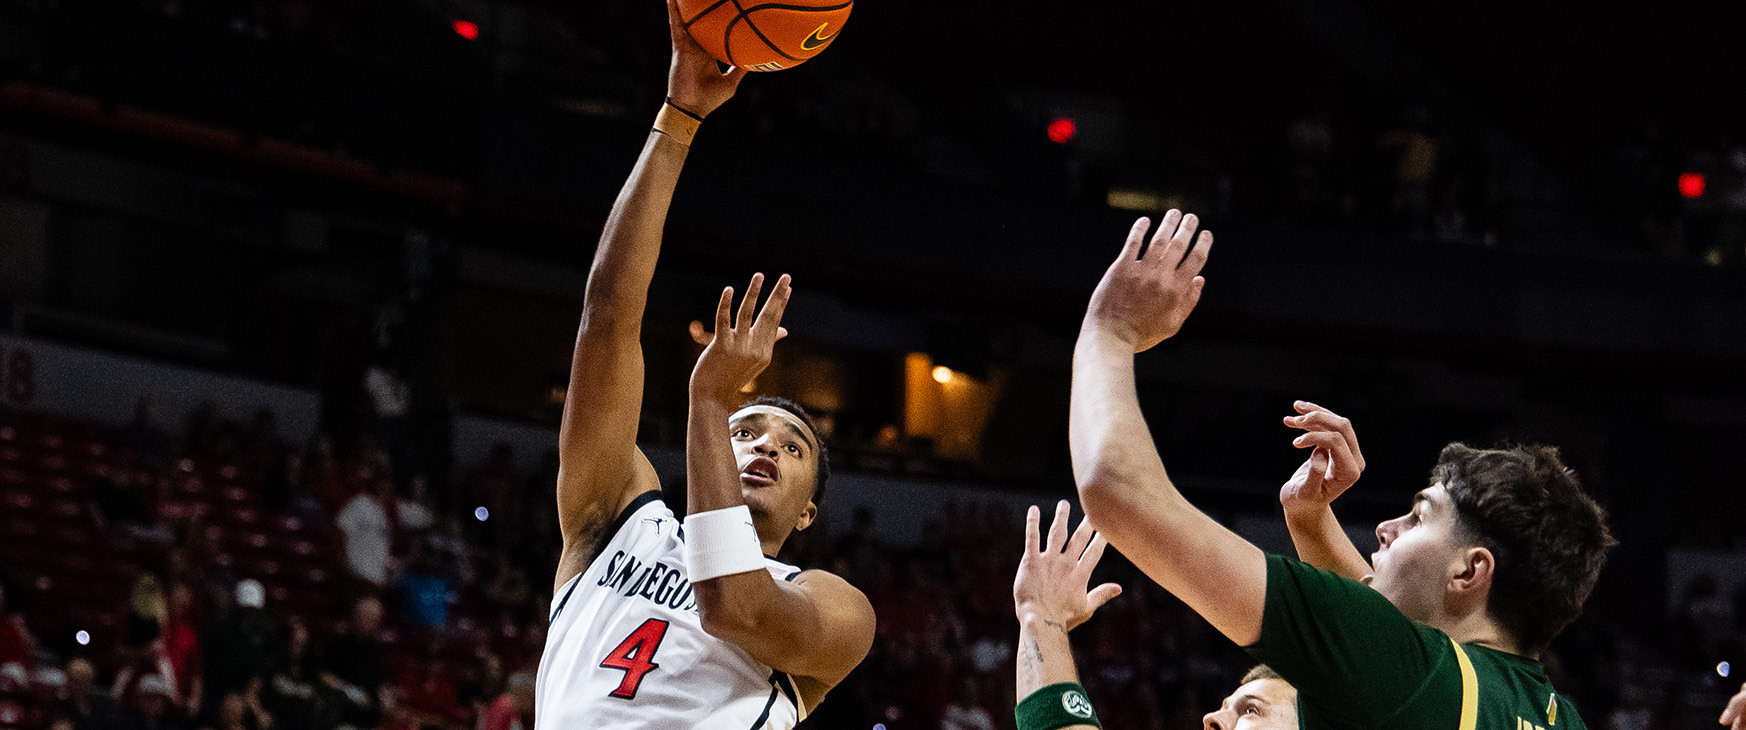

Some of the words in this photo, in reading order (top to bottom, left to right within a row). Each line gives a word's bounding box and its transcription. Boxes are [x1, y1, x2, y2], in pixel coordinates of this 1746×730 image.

[597, 550, 642, 593] SN
[624, 562, 693, 609] DEGO
[600, 618, 669, 699] 4
